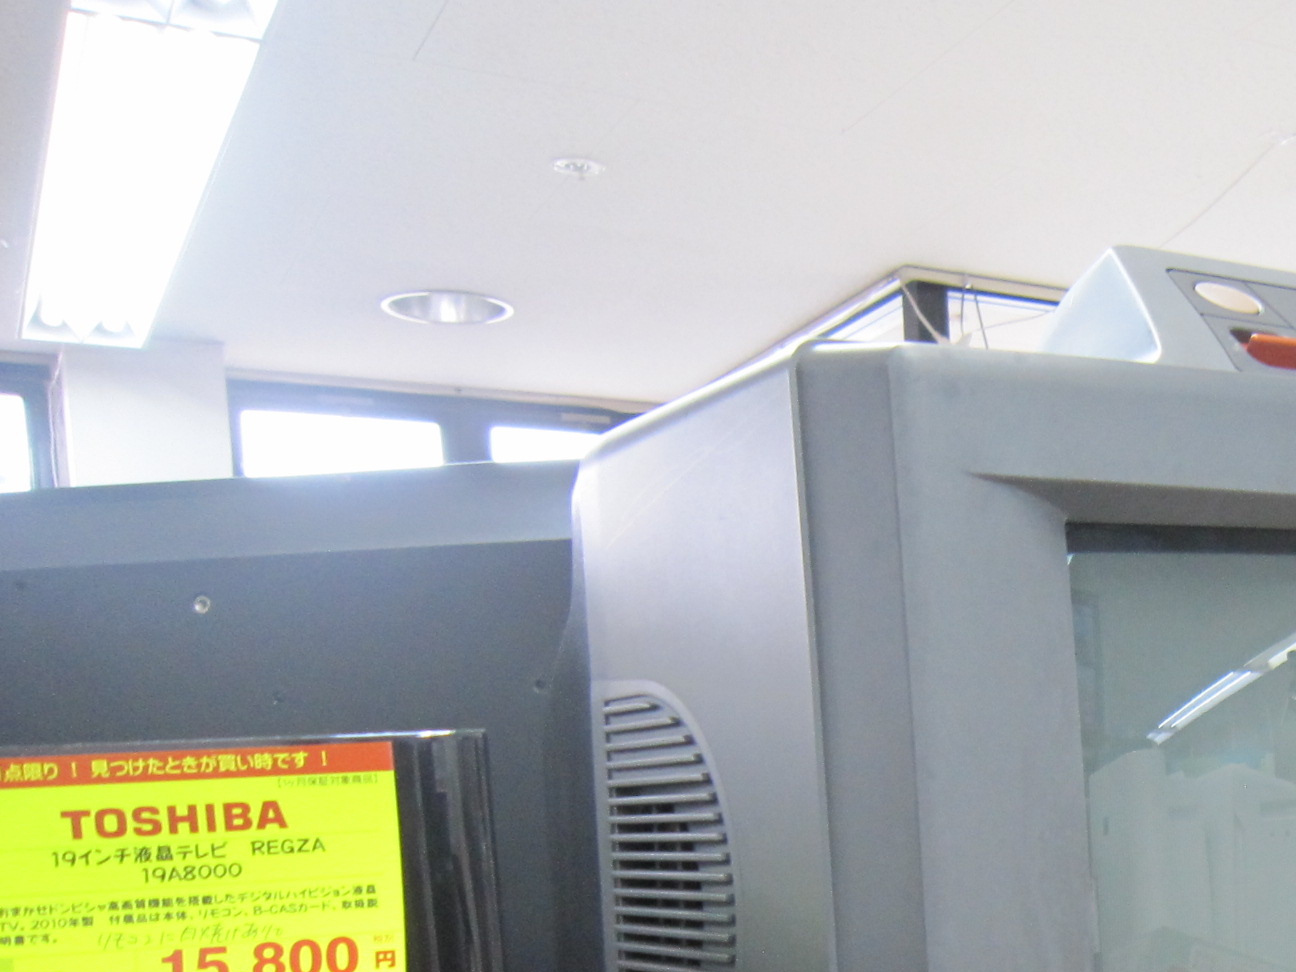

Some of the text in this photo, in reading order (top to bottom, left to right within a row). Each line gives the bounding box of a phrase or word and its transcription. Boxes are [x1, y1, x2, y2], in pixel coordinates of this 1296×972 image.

[61, 800, 288, 840] TOSHIBA
[52, 838, 326, 868] 19インチ液晶テレビ REGZA
[141, 862, 243, 884] 19A8000
[374, 949, 396, 969] 円
